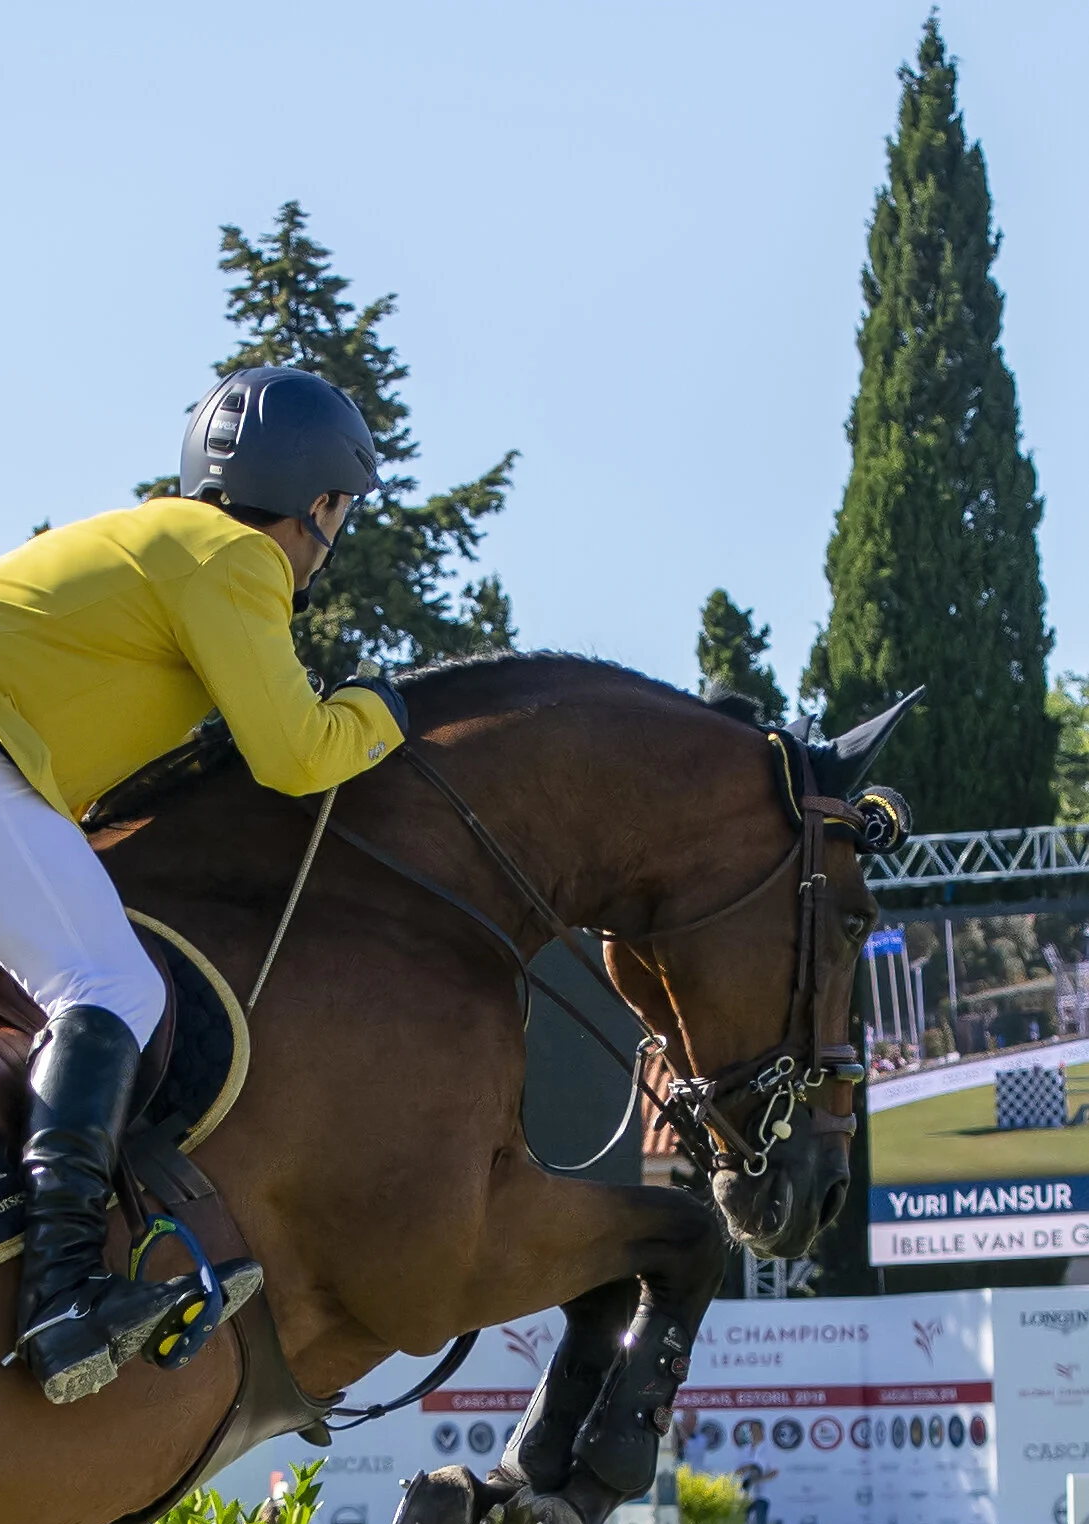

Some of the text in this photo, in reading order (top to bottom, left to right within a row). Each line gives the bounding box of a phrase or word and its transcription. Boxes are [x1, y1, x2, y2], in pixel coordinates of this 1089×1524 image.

[953, 1183, 1073, 1215] MANSUR
[973, 1230, 1024, 1251] VAN
[1033, 1229, 1064, 1248] DE
[725, 1324, 870, 1346] CHAMPIONS
[709, 1352, 785, 1368] LEAGUE
